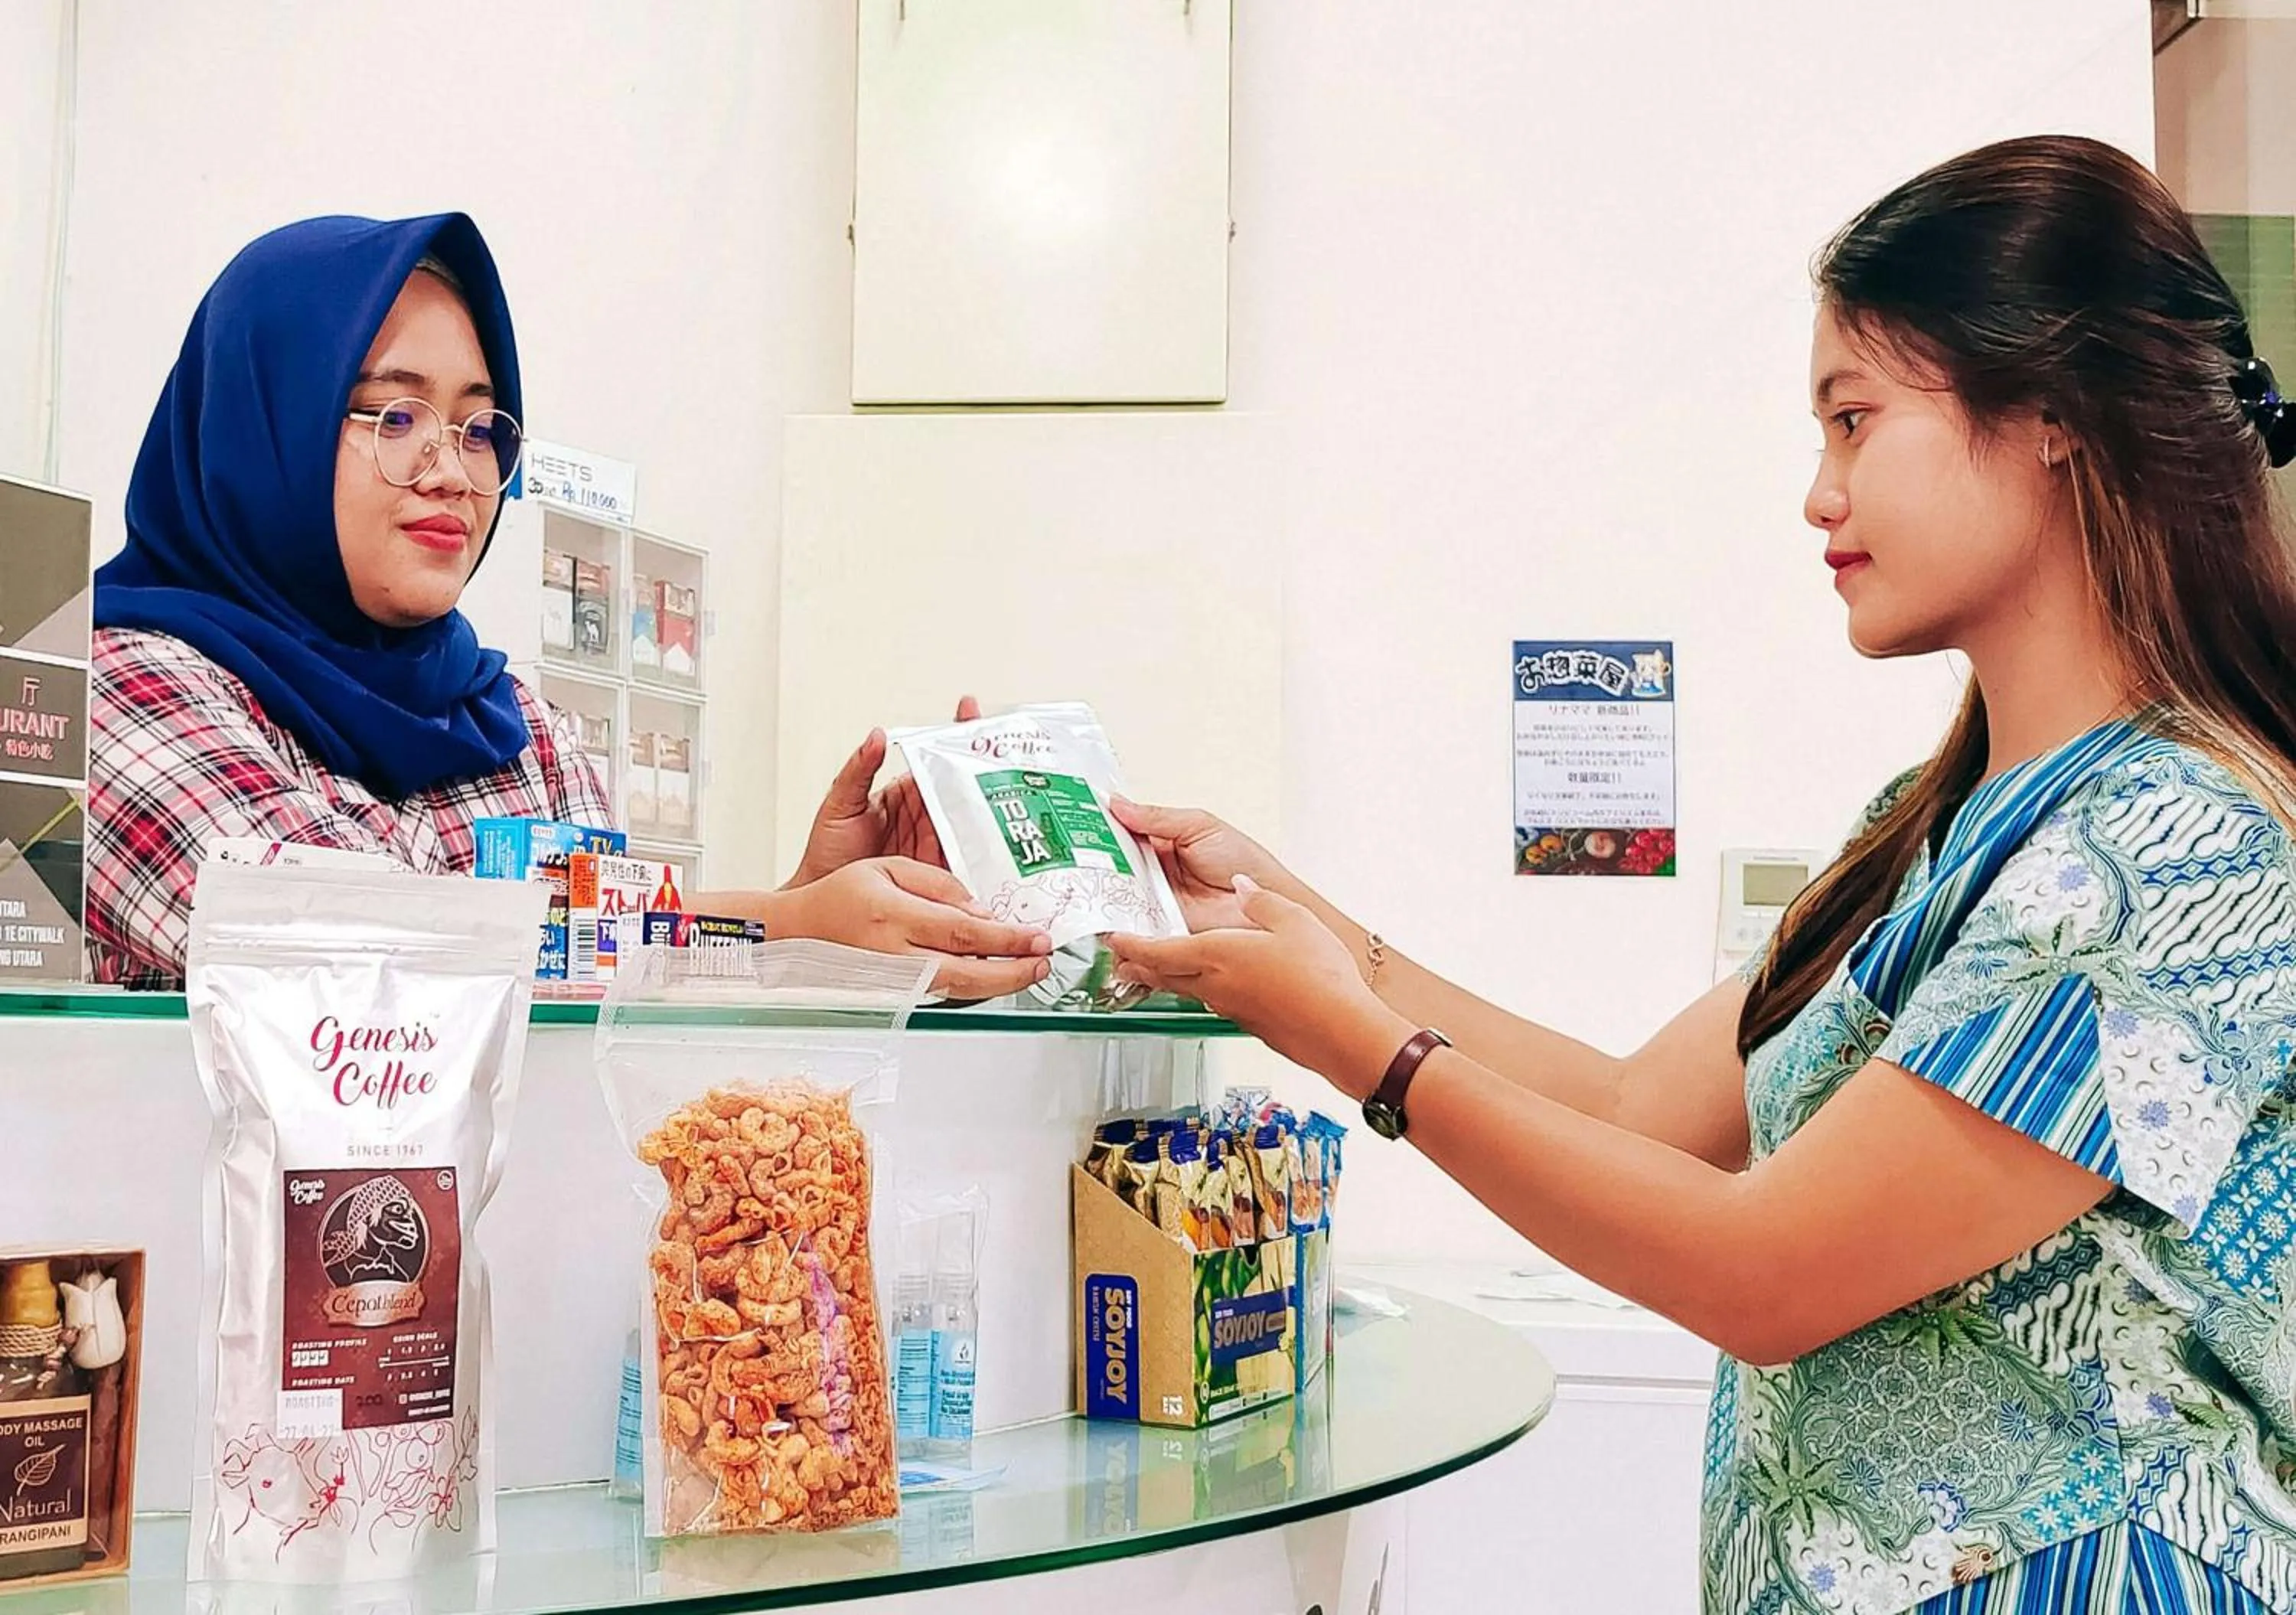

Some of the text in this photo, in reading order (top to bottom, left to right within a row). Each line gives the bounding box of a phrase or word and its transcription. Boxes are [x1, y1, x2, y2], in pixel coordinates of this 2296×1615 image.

[532, 453, 593, 482] HEETS
[1517, 650, 1628, 695] お惣菜屋
[1006, 820, 1045, 843] RA
[1022, 840, 1052, 865] JA
[0, 900, 26, 918] TARA
[310, 1016, 439, 1072] Genesis
[333, 1060, 438, 1110] Coffee
[347, 1145, 390, 1157] SINCE
[1214, 1310, 1267, 1349] SOYJOY
[1105, 1287, 1127, 1405] SOYJOY
[24, 1417, 83, 1434] MASSAGE
[24, 1435, 45, 1448] OIL
[0, 1486, 72, 1523] Natural
[0, 1525, 72, 1545] RANGIPANI
